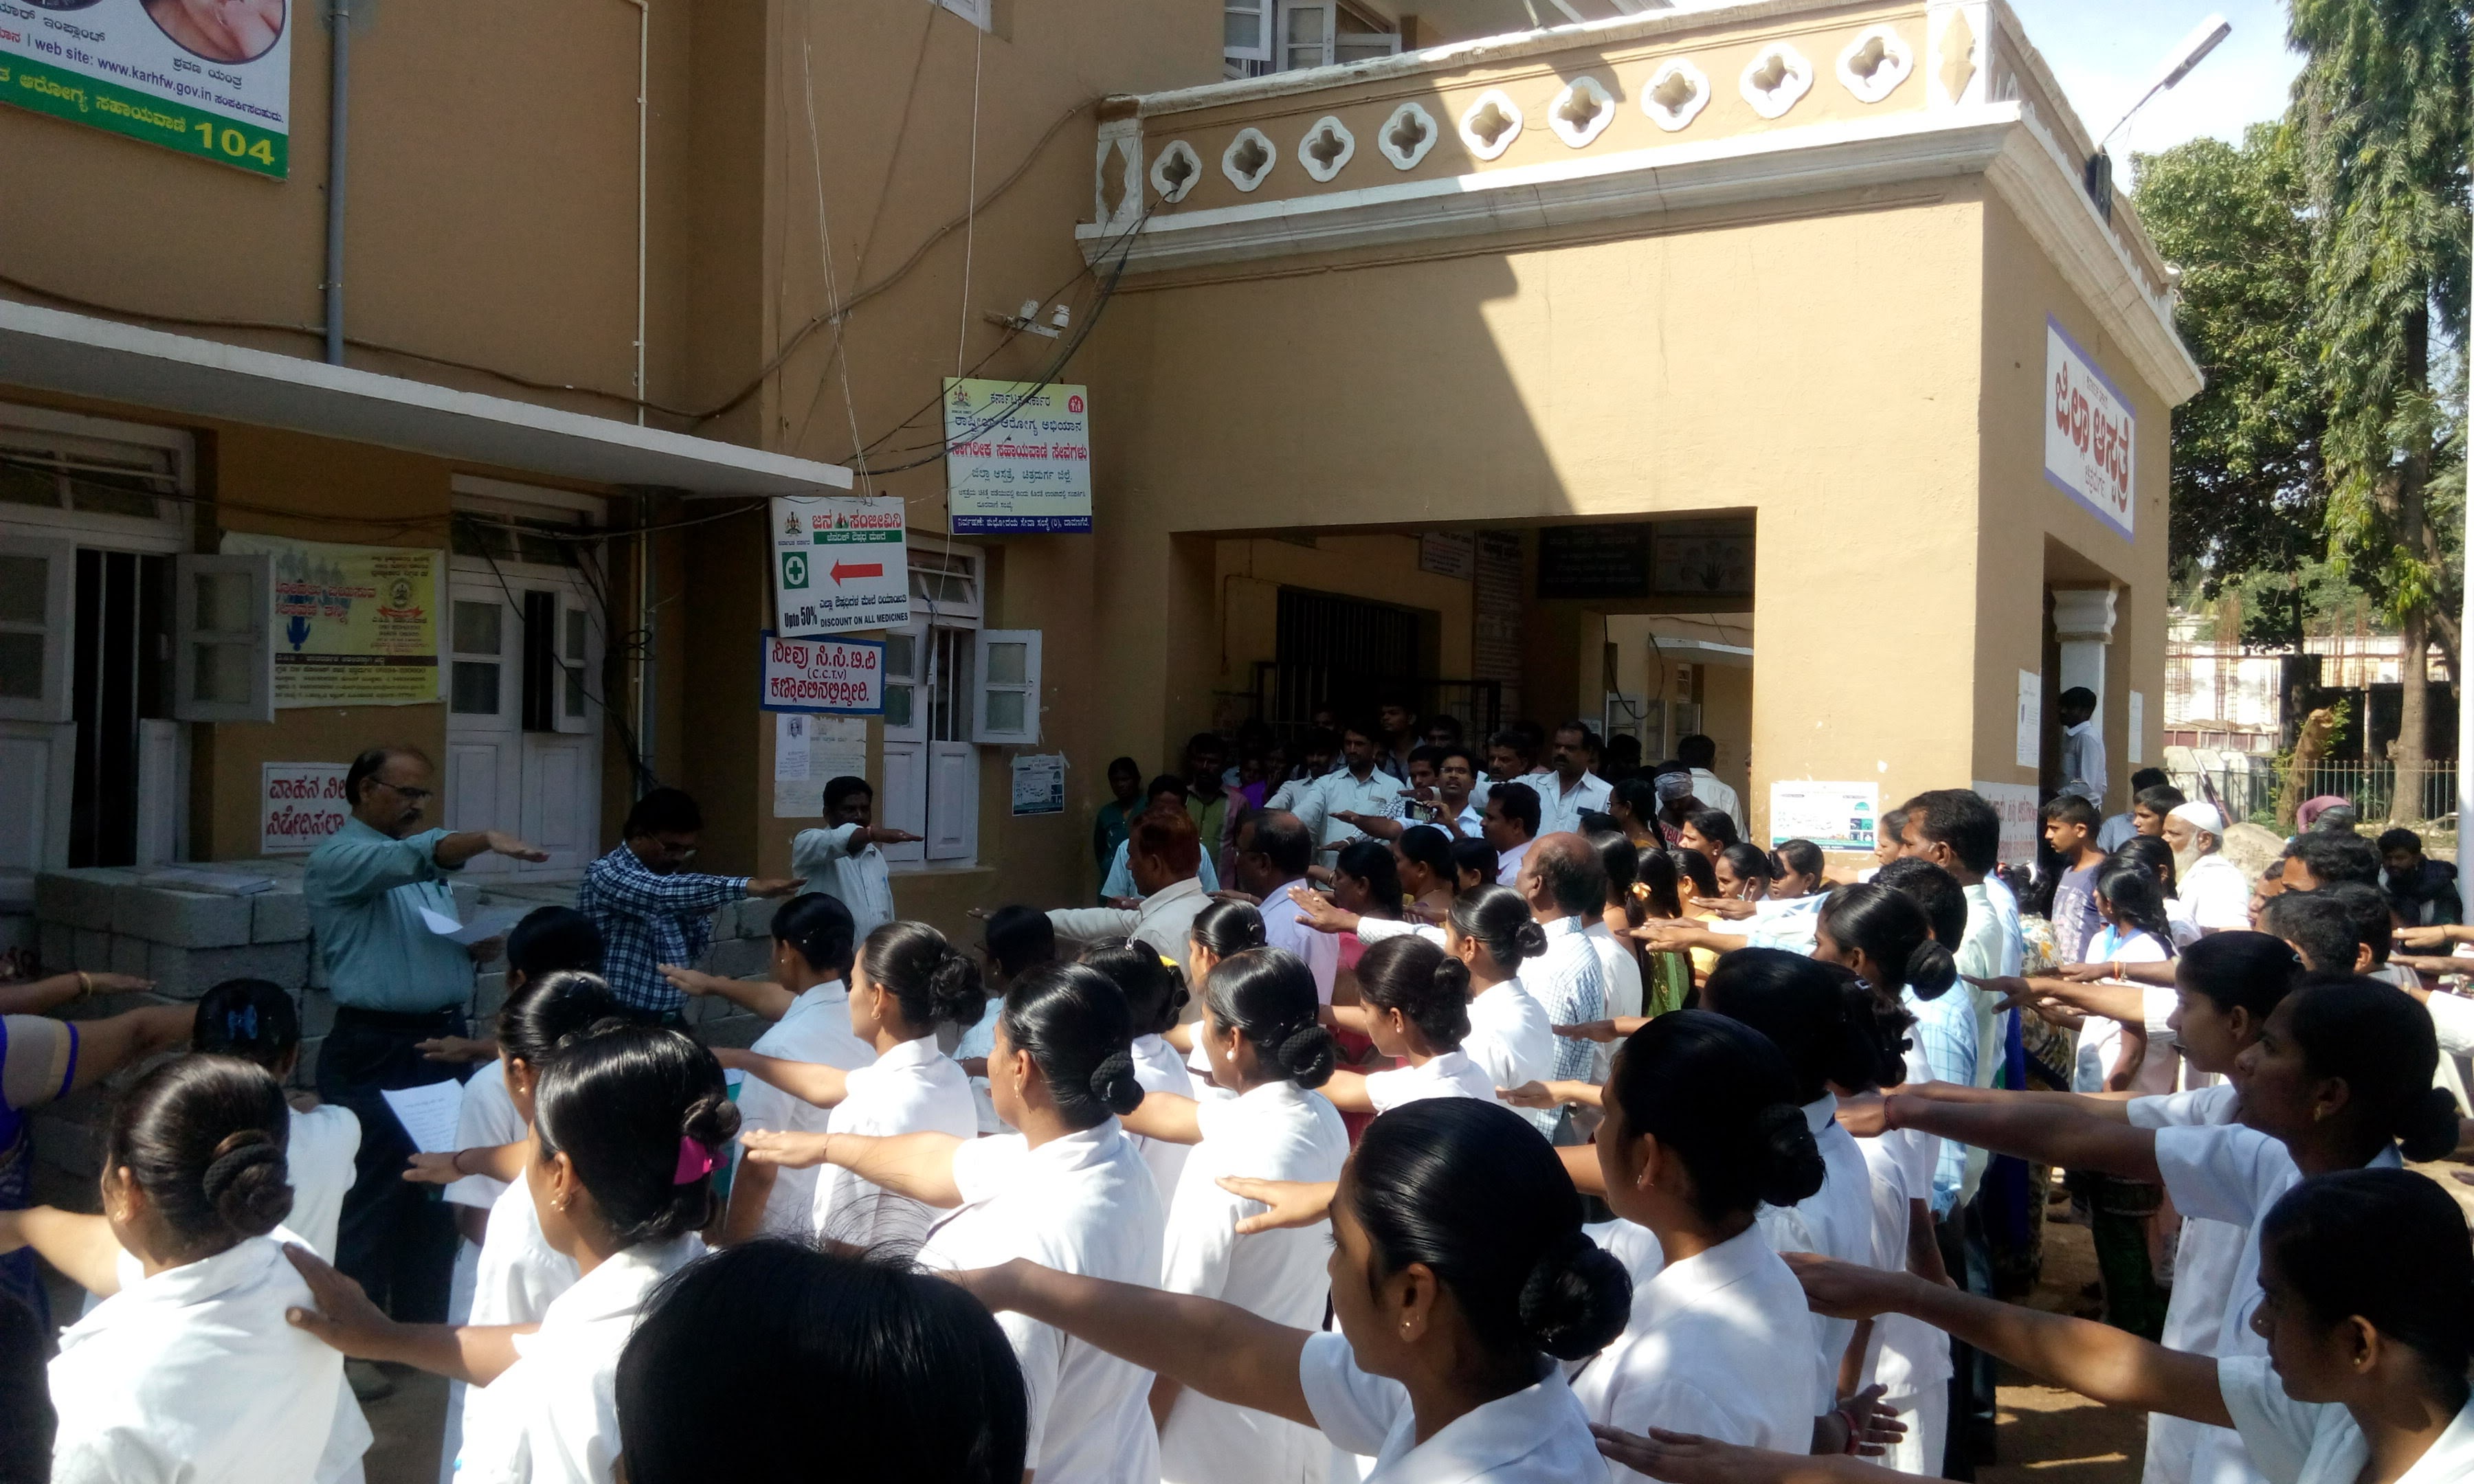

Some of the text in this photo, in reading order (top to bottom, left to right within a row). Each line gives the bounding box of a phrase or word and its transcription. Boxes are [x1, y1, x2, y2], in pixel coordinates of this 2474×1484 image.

[35, 38, 62, 56] web
[66, 47, 93, 65] site:
[98, 57, 212, 101] www.karhfw.gov.in
[208, 69, 242, 89] ಯಂತ್ರ
[19, 74, 88, 113] ಆರೋಗ್ಯ
[96, 95, 187, 133] ಸಹಾಯವಾಣಿ
[194, 122, 275, 166] 104
[1001, 416, 1038, 436] ಆರೋಗ್ಯ
[1042, 419, 1082, 433] ಅಭಿಯಾನ
[2055, 361, 2129, 513] ಜಿಲ್ಲಾ ಆಸ್ಪತ್ರೆ
[996, 441, 1048, 459] ಸಹಾಯವಾಣಿ
[1052, 442, 1087, 460] ಸೇವೆಗಳು
[972, 468, 990, 482] ಜಿಲ್ಲಾ
[1023, 469, 1054, 484] ಚಿತ್ರದುರ್ಗ
[812, 509, 902, 530] ಜನ ಸಂಜೀವಿನಿ
[784, 605, 818, 629] Upto 50%
[821, 612, 909, 627] DISCOUNT ON ALL MEDICINES
[772, 640, 809, 670] ನೀವು
[807, 667, 847, 680] (C.C.T.V)
[269, 774, 320, 800] ವಾಹನ
[267, 805, 345, 841] ನಿಷೇಧಿಸಲಾ
